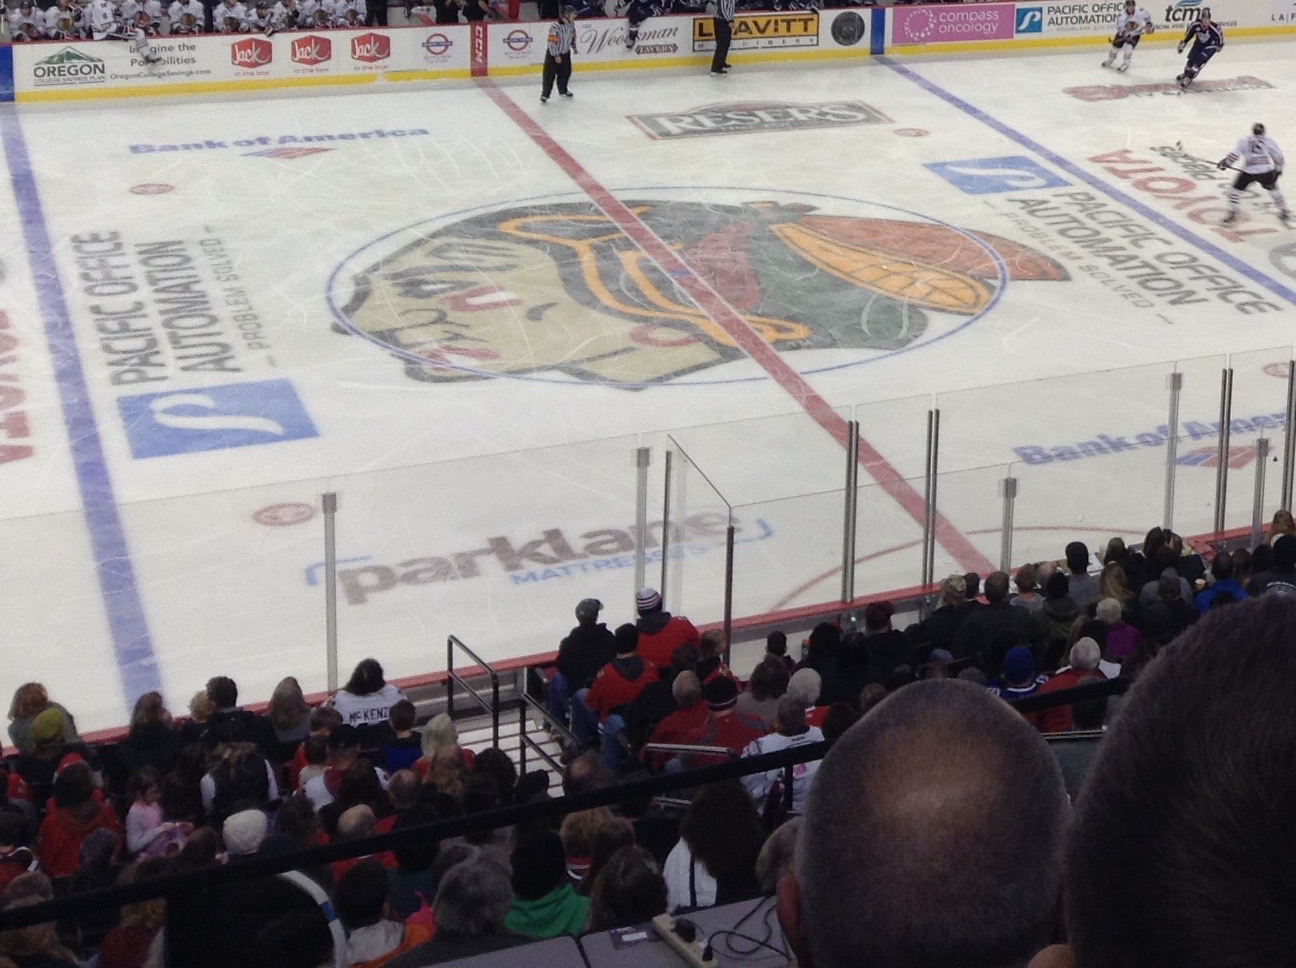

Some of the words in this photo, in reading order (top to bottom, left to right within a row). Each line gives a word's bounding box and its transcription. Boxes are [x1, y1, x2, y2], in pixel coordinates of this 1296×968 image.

[939, 12, 999, 25] compass
[1047, 2, 1089, 15] PACIFIC
[1091, 2, 1126, 14] OFFIC
[698, 17, 815, 37] LAVITT
[939, 22, 999, 35] oncology
[180, 41, 197, 53] the
[233, 41, 271, 63] Jack
[294, 38, 331, 61] Jack
[353, 35, 390, 58] Jack
[640, 44, 676, 53] TAVERN
[33, 63, 106, 78] OREGON
[129, 140, 228, 153] Bank
[233, 136, 271, 146] of
[279, 128, 430, 145] America
[1006, 198, 1210, 306] AUTOMATION
[1052, 191, 1174, 249] PACIFIC
[1154, 250, 1284, 315] OFFICE
[71, 230, 138, 298] OFFICE
[134, 239, 243, 373] AUTOMATION
[89, 299, 169, 387] PACIFIC
[1015, 434, 1128, 465] Bank
